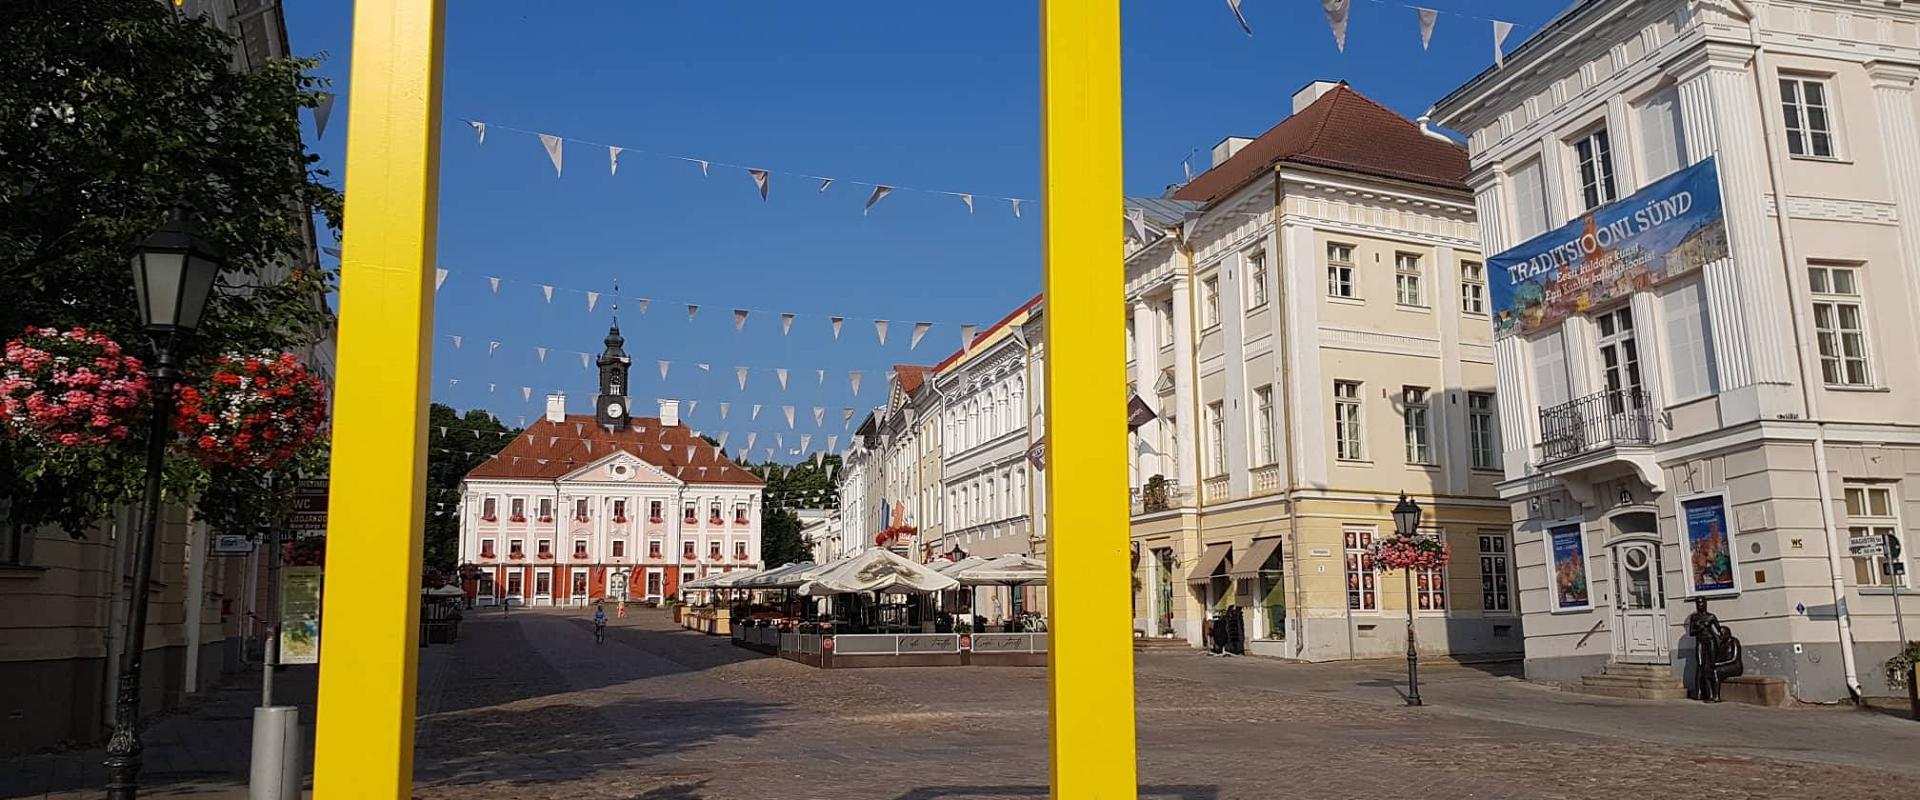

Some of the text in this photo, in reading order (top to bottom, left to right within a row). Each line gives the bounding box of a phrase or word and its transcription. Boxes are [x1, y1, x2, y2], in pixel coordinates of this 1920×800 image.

[1507, 191, 1692, 285] TRADITSIOONI SÜND
[1556, 268, 1578, 283] Eesti
[1615, 242, 1640, 261] kunst
[293, 499, 311, 509] WC
[1791, 538, 1803, 546] WC
[1849, 546, 1862, 555] WC
